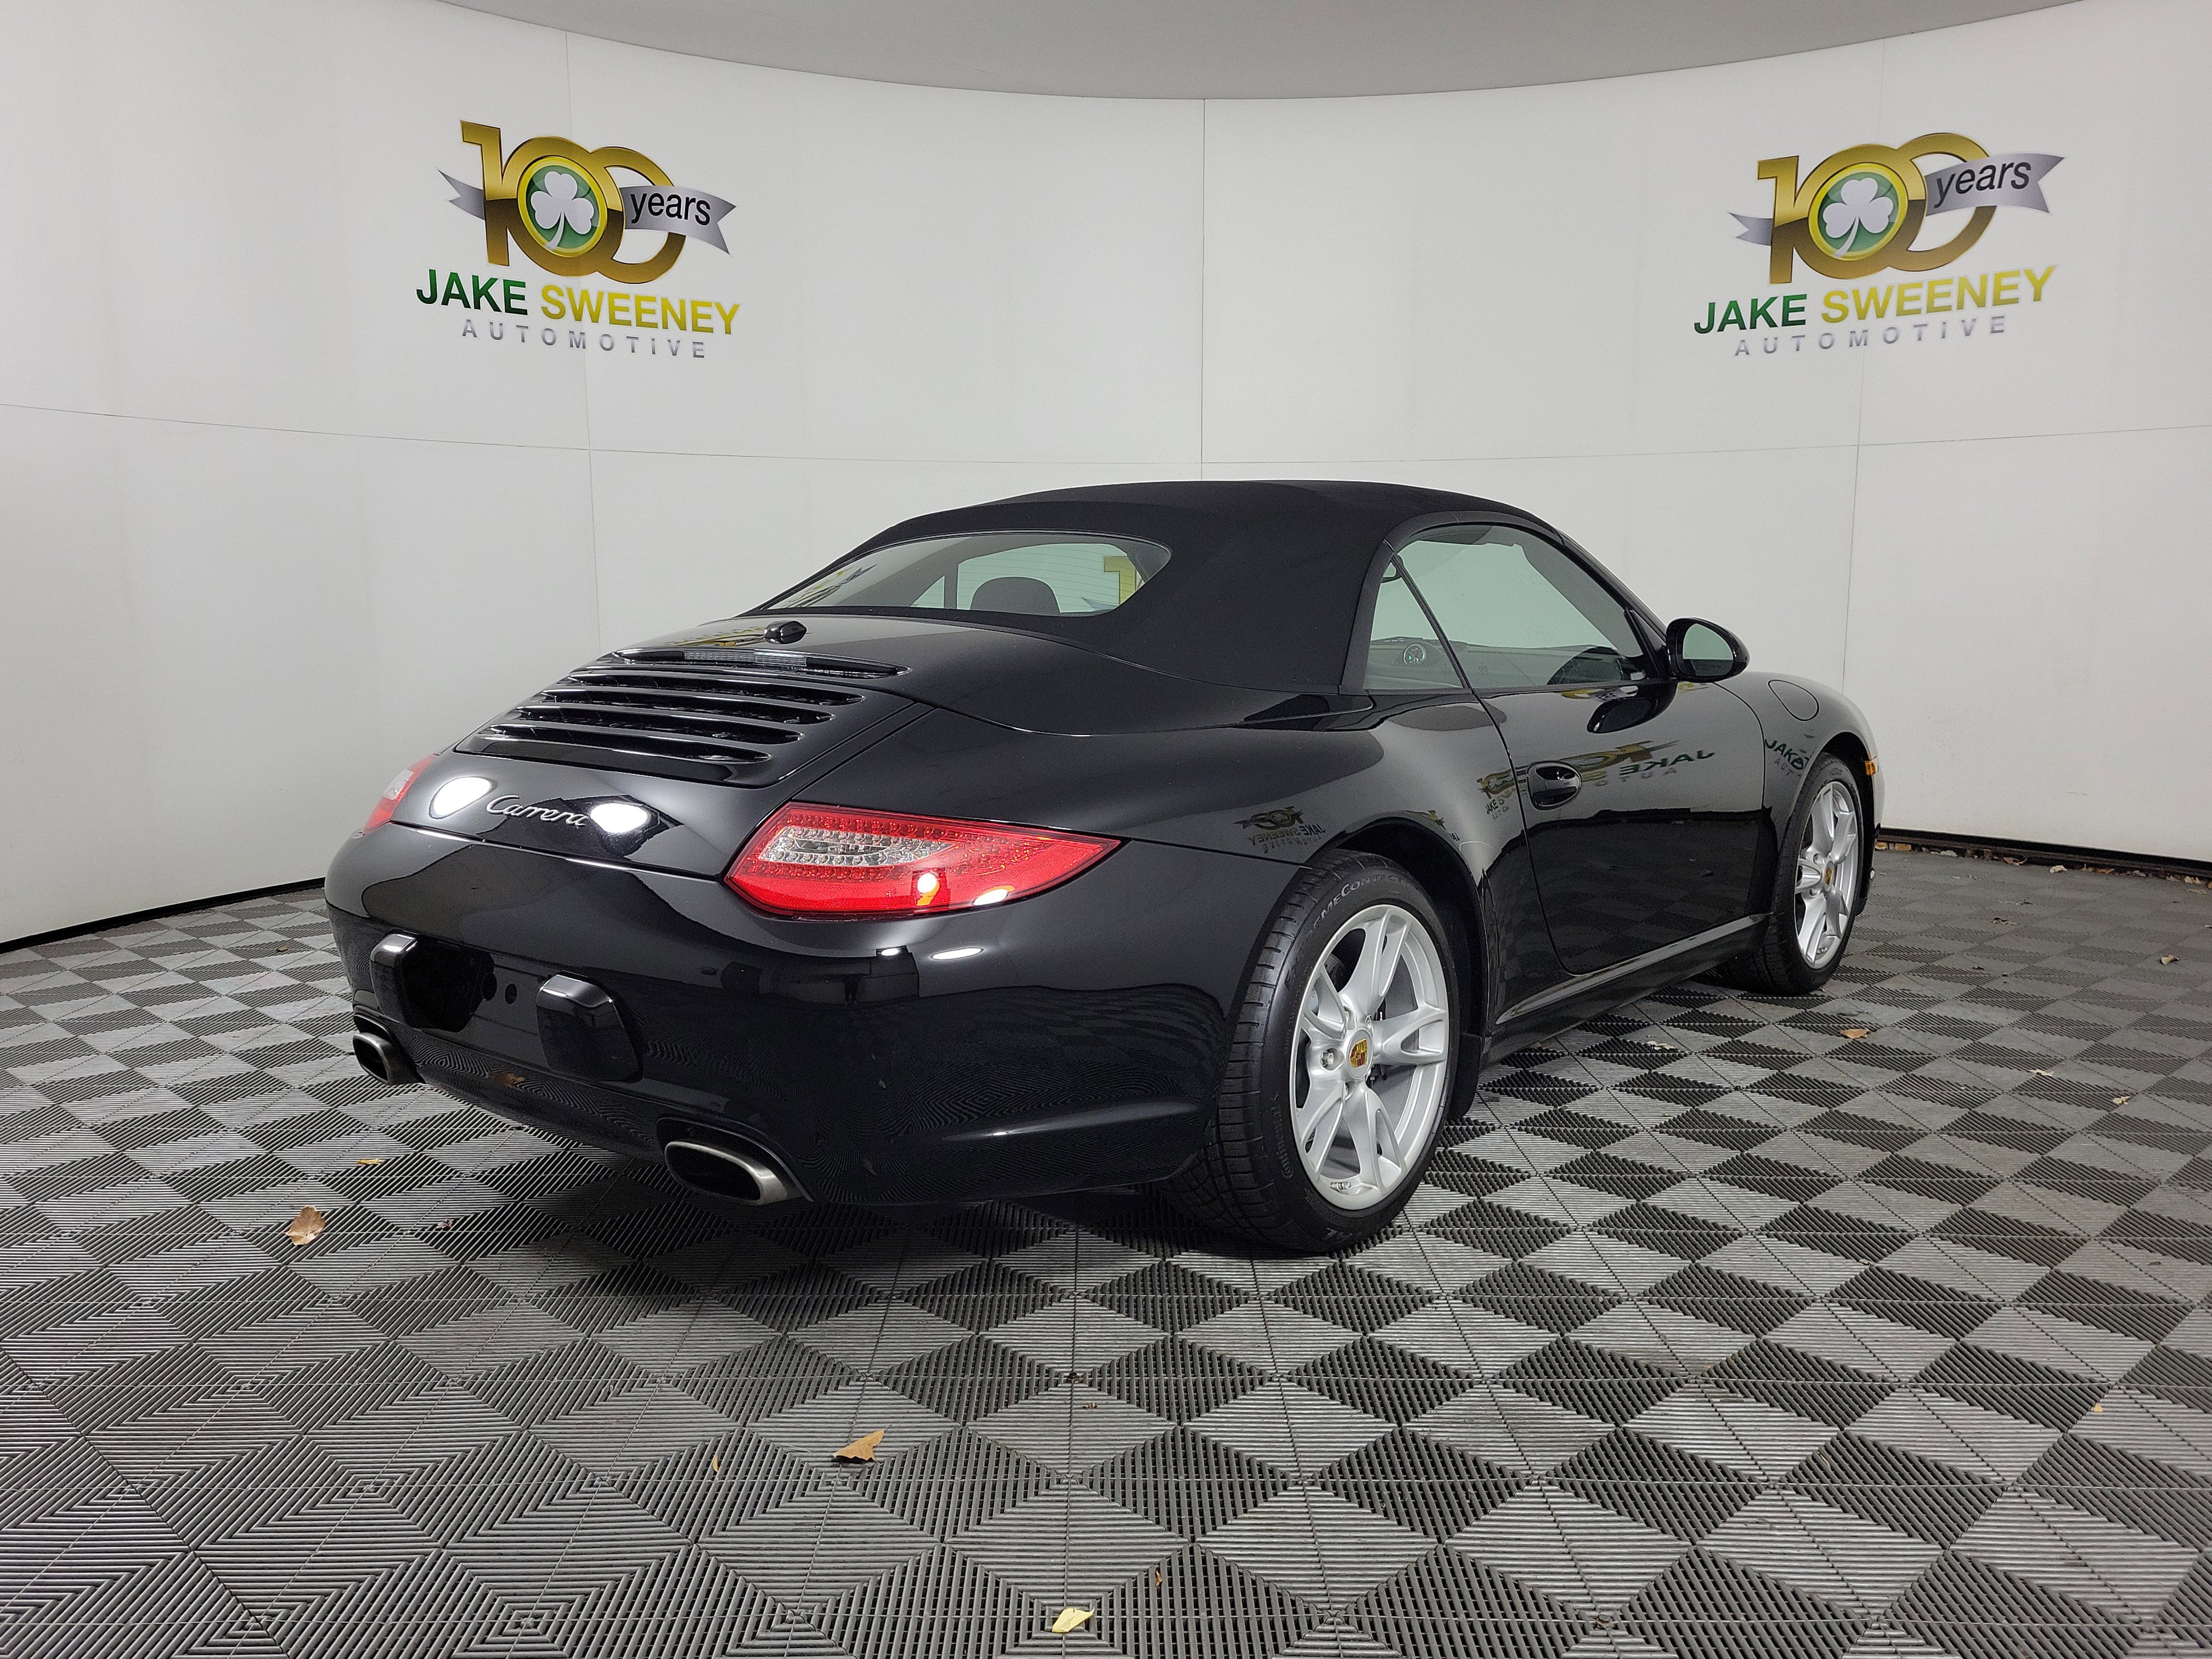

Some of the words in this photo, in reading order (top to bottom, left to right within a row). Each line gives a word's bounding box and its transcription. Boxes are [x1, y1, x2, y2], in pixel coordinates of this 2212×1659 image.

[1934, 160, 2031, 208] years
[630, 191, 712, 226] years
[416, 269, 528, 316] JAKE
[541, 284, 741, 335] SWEENEY
[1694, 294, 1807, 334] JAKE
[1821, 266, 2057, 324] SWEENEY
[462, 319, 705, 359] AUTOMOTIVE
[1734, 315, 2006, 357] AUTOMOTIVE
[486, 794, 589, 827] Carrera
